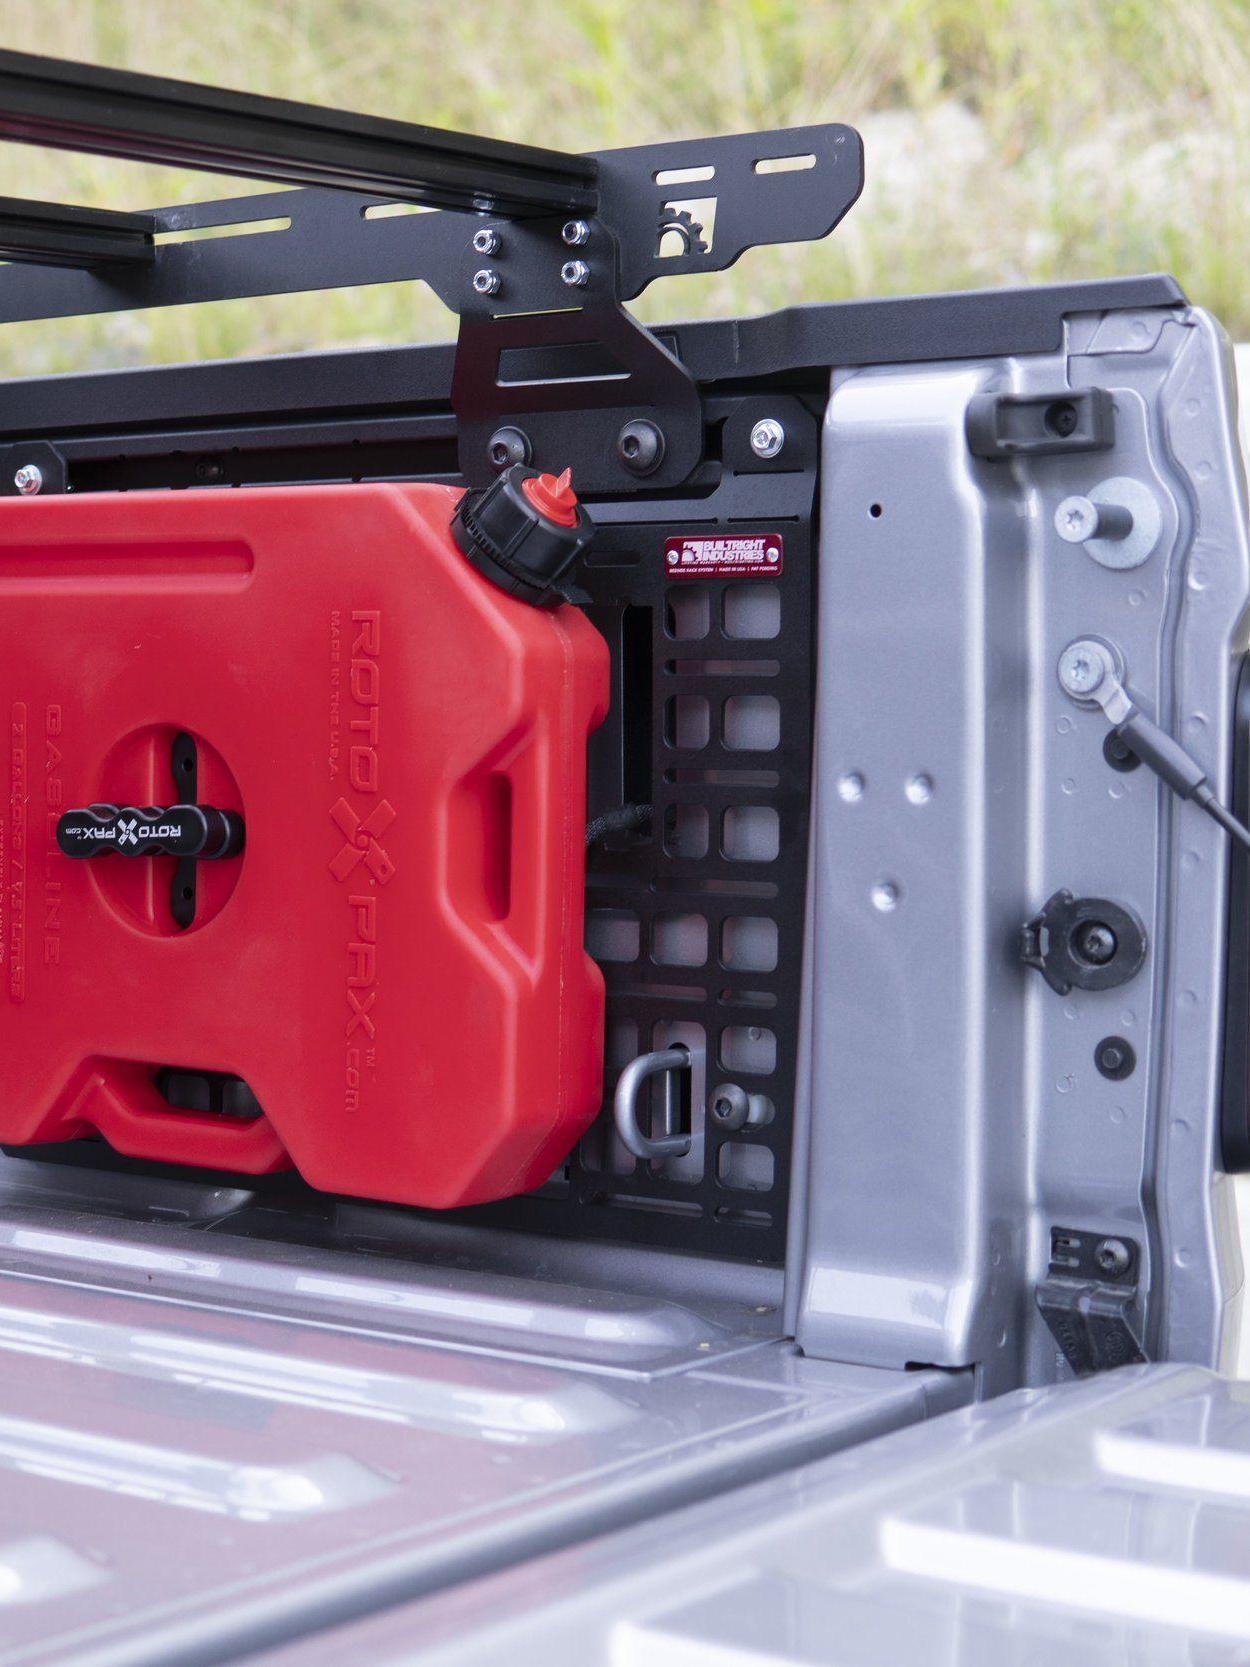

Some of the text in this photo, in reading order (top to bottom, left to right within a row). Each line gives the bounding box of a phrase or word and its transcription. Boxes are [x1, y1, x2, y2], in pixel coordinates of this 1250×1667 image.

[703, 539, 766, 550] BUILTRIGHT
[703, 549, 764, 561] INDUSTRIES
[329, 610, 341, 781] MADE IN THE U.S.A.
[350, 610, 381, 793] ROTO
[12, 722, 24, 736] 2
[12, 748, 24, 850] GALLONS
[44, 704, 63, 964] GASOLINE
[139, 825, 181, 838] ROTO
